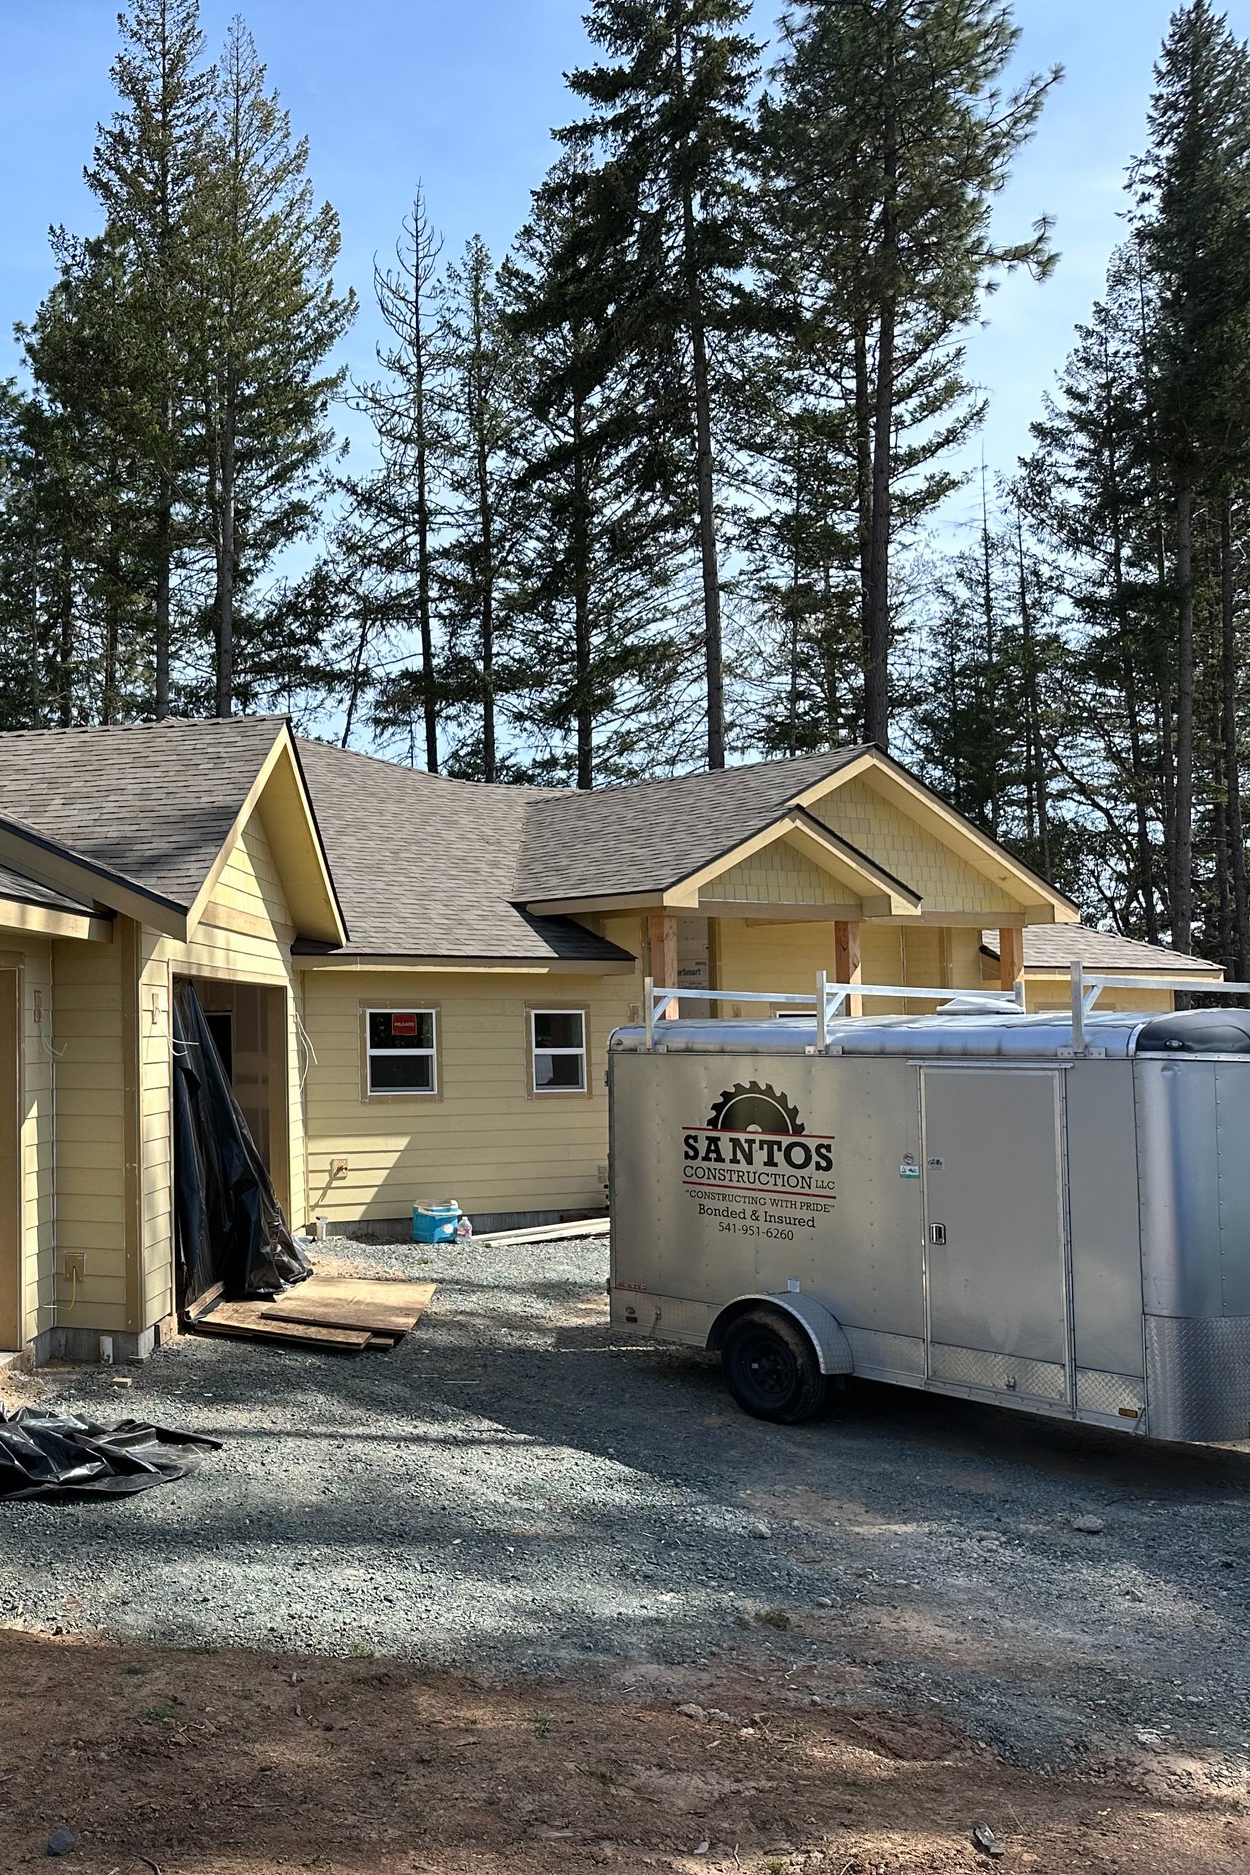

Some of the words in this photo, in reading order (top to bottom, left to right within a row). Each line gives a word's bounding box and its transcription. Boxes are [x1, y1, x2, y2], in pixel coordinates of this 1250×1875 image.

[683, 1134, 833, 1172] SANTOS
[682, 1165, 813, 1190] CONSTRUCTION
[815, 1179, 835, 1190] LLC
[698, 1203, 747, 1220] Bonded
[750, 1209, 761, 1222] &
[763, 1211, 816, 1228] Insured
[769, 1198, 798, 1210] WITH
[718, 1221, 794, 1241] 541-951-6260
